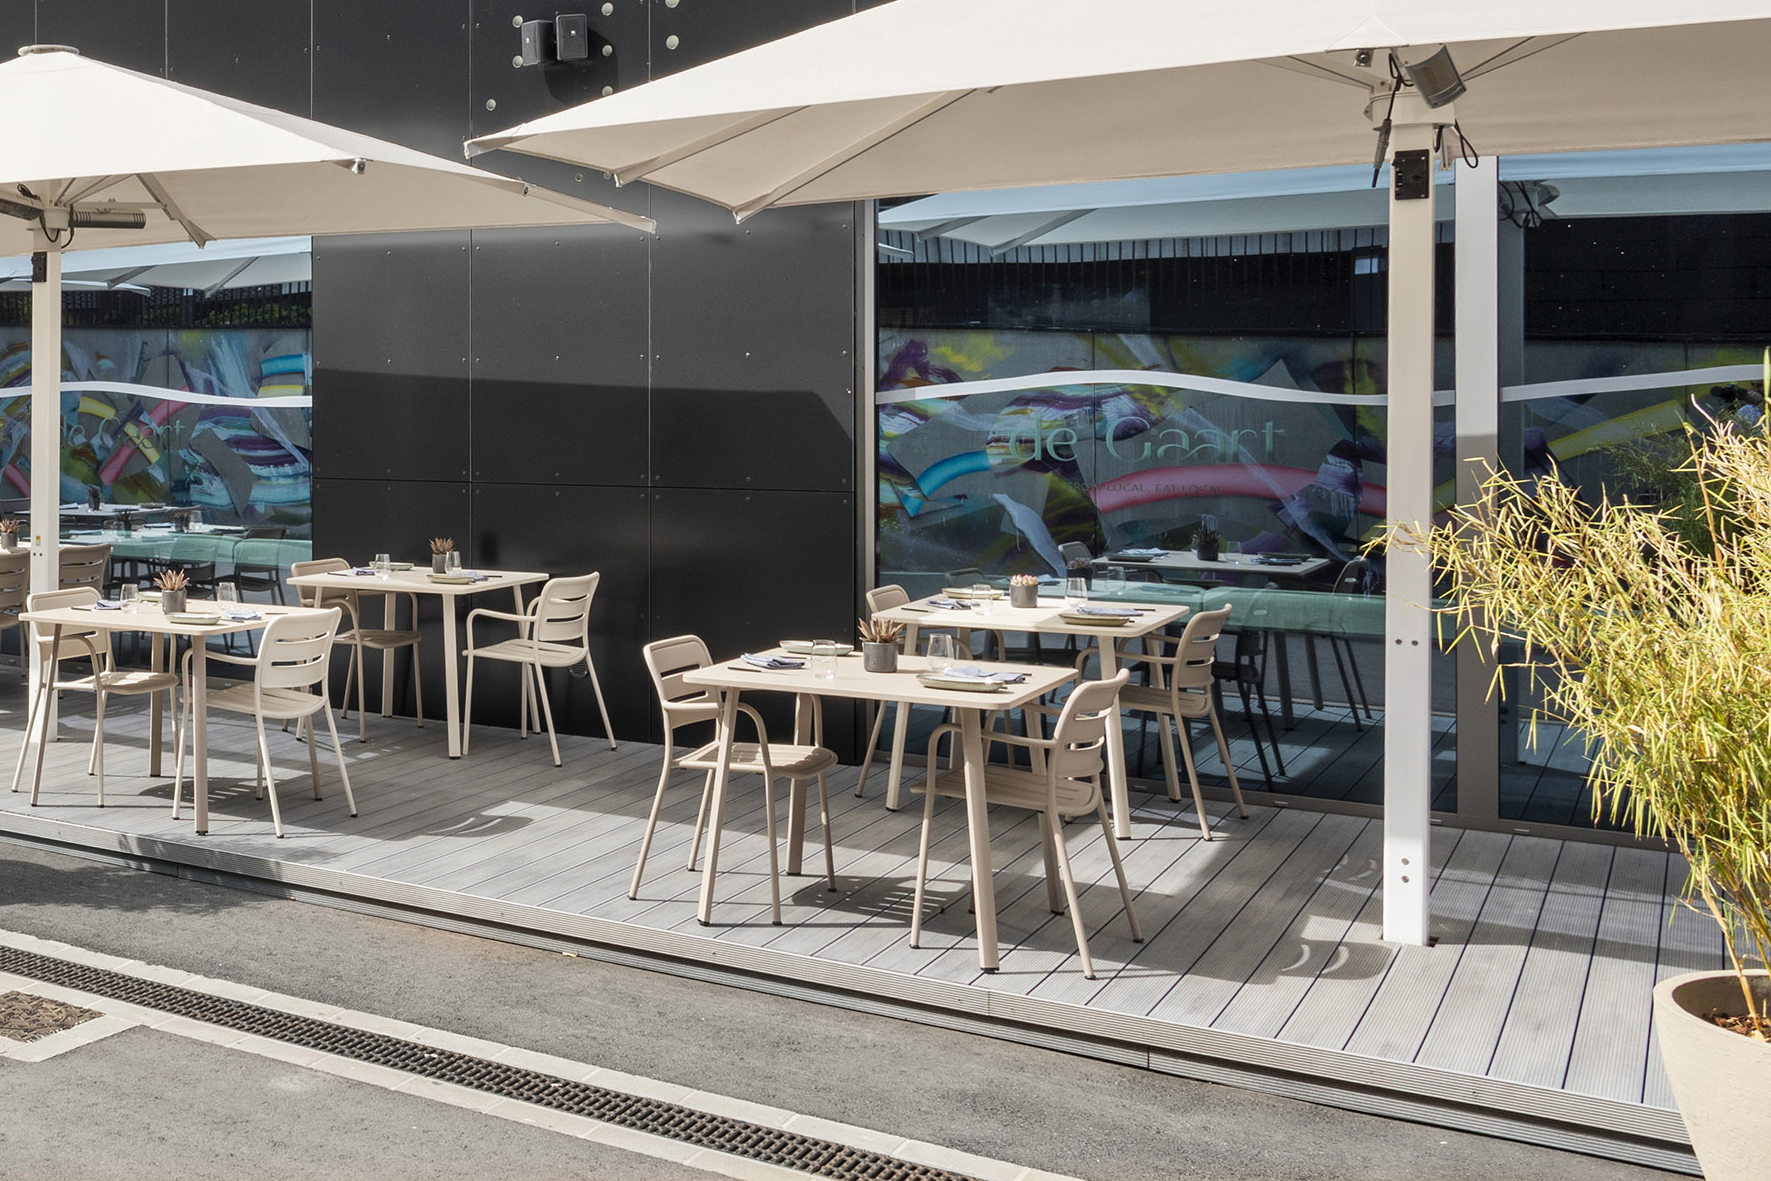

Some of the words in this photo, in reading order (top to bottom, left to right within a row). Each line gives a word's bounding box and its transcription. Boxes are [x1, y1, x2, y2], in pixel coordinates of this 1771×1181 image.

[99, 416, 185, 450] Gaart
[1008, 417, 1078, 462] de
[1105, 416, 1285, 464] Gaart
[1066, 483, 1101, 492] GROW
[1107, 483, 1150, 494] LOCAL,
[1155, 484, 1177, 493] EAT
[1182, 484, 1222, 494] LOCAL
